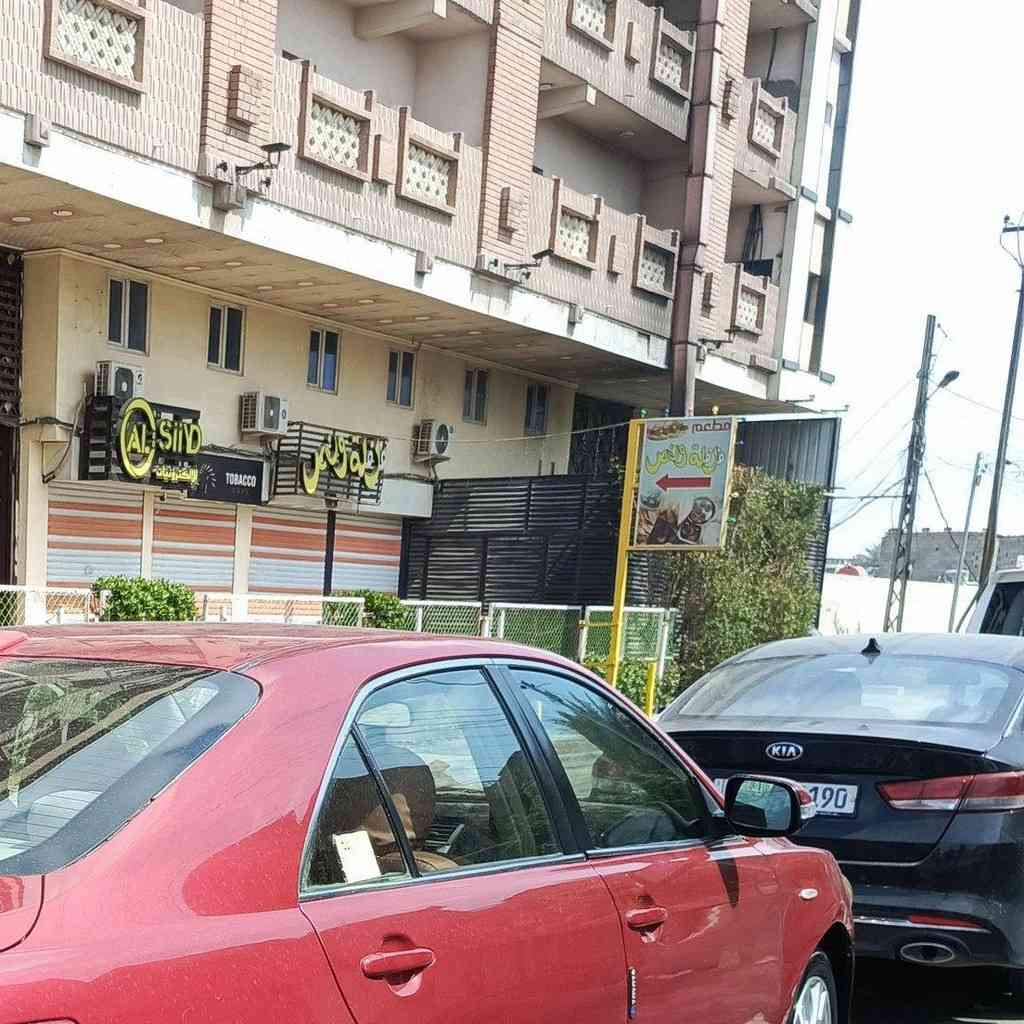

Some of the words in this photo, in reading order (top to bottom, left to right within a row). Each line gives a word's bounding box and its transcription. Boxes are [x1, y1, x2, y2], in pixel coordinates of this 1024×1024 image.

[691, 420, 731, 433] مطعم
[225, 472, 257, 488] TOBACCO
[771, 744, 797, 757] KIA
